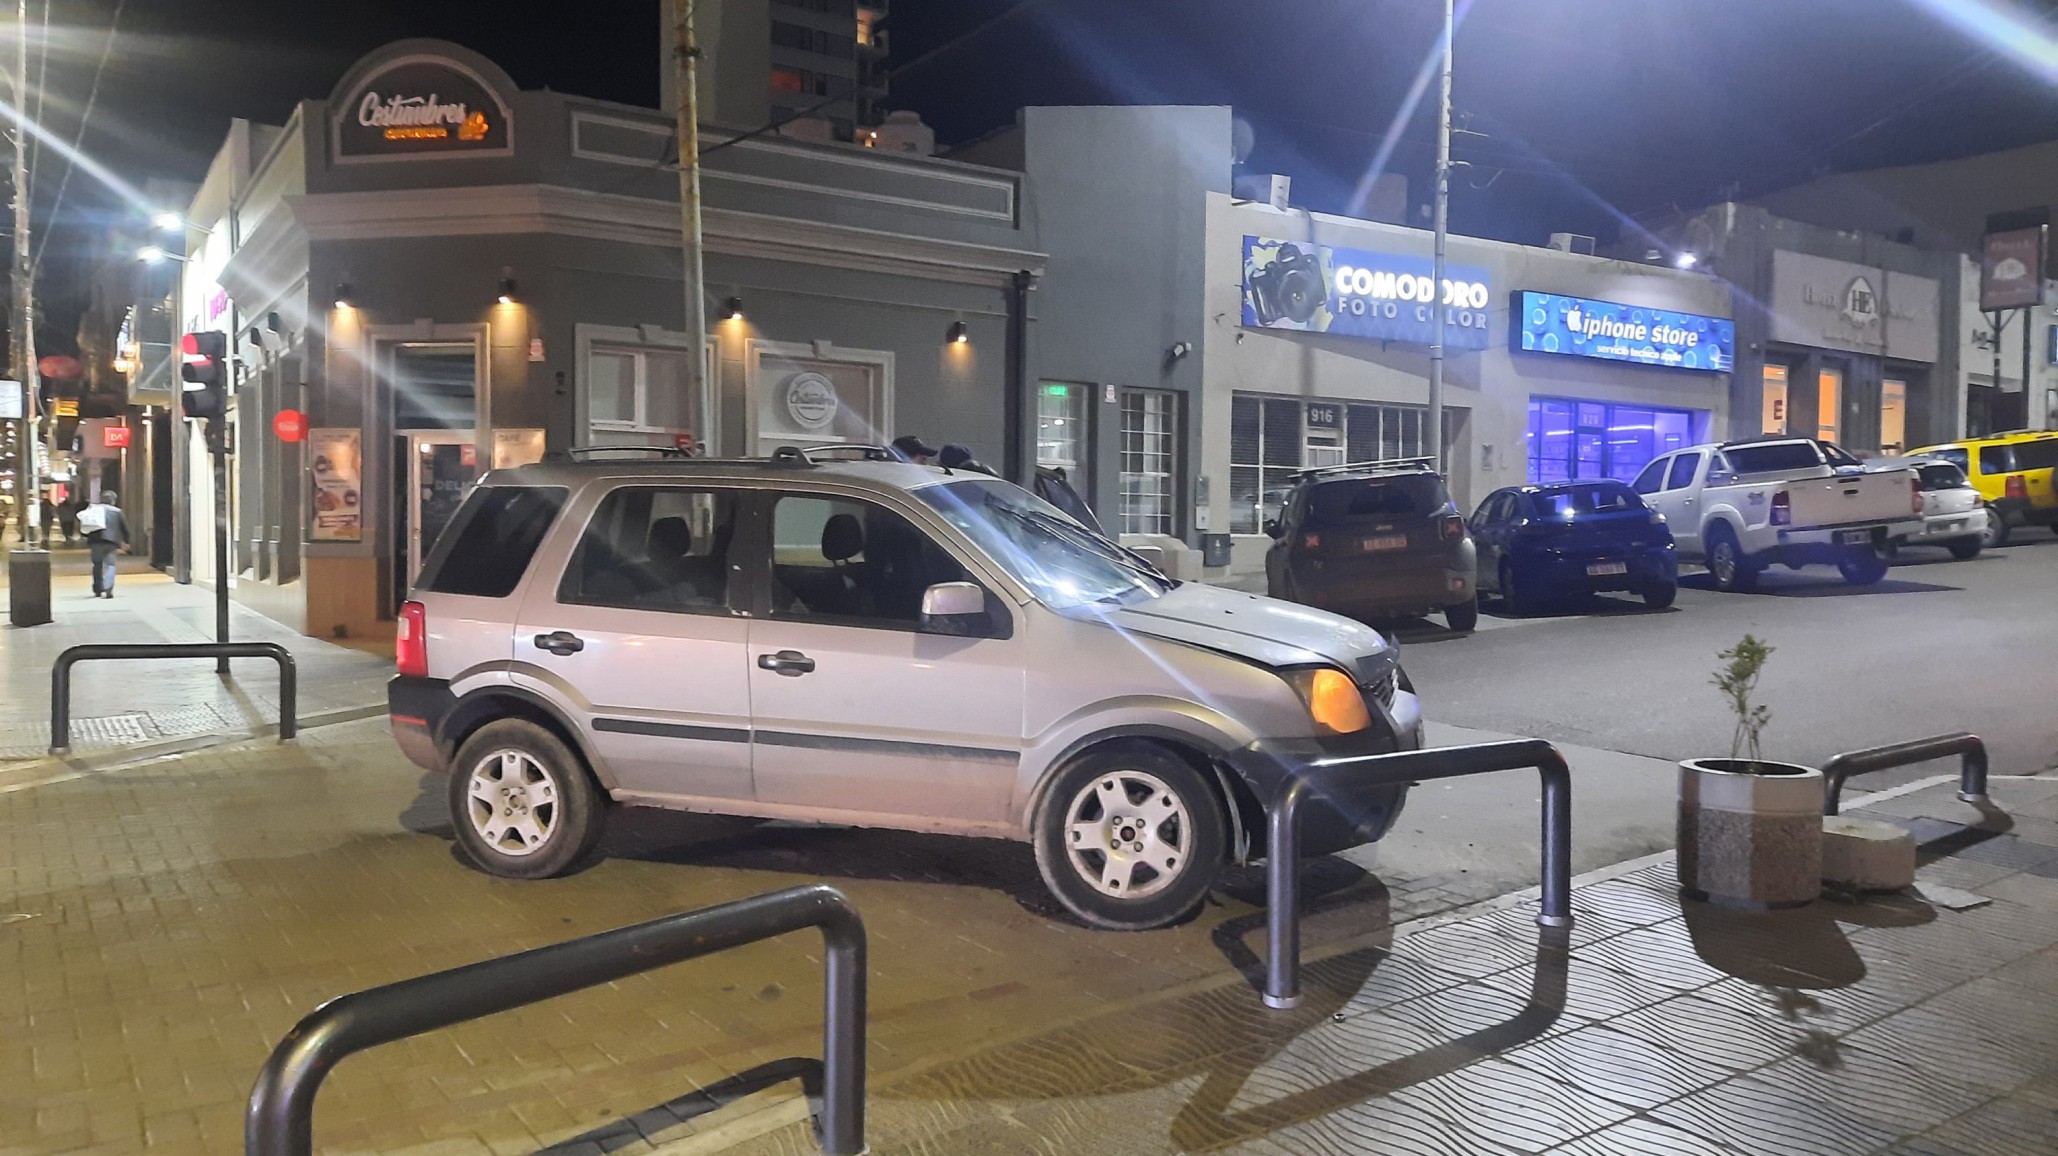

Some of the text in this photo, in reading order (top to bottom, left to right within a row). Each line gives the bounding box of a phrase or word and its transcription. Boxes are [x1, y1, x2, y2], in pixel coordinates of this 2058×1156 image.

[1338, 297, 1487, 329] FOTO CLOR
[1582, 312, 1699, 347] iphone store
[1596, 345, 1629, 356] servicio
[1311, 408, 1333, 423] 916
